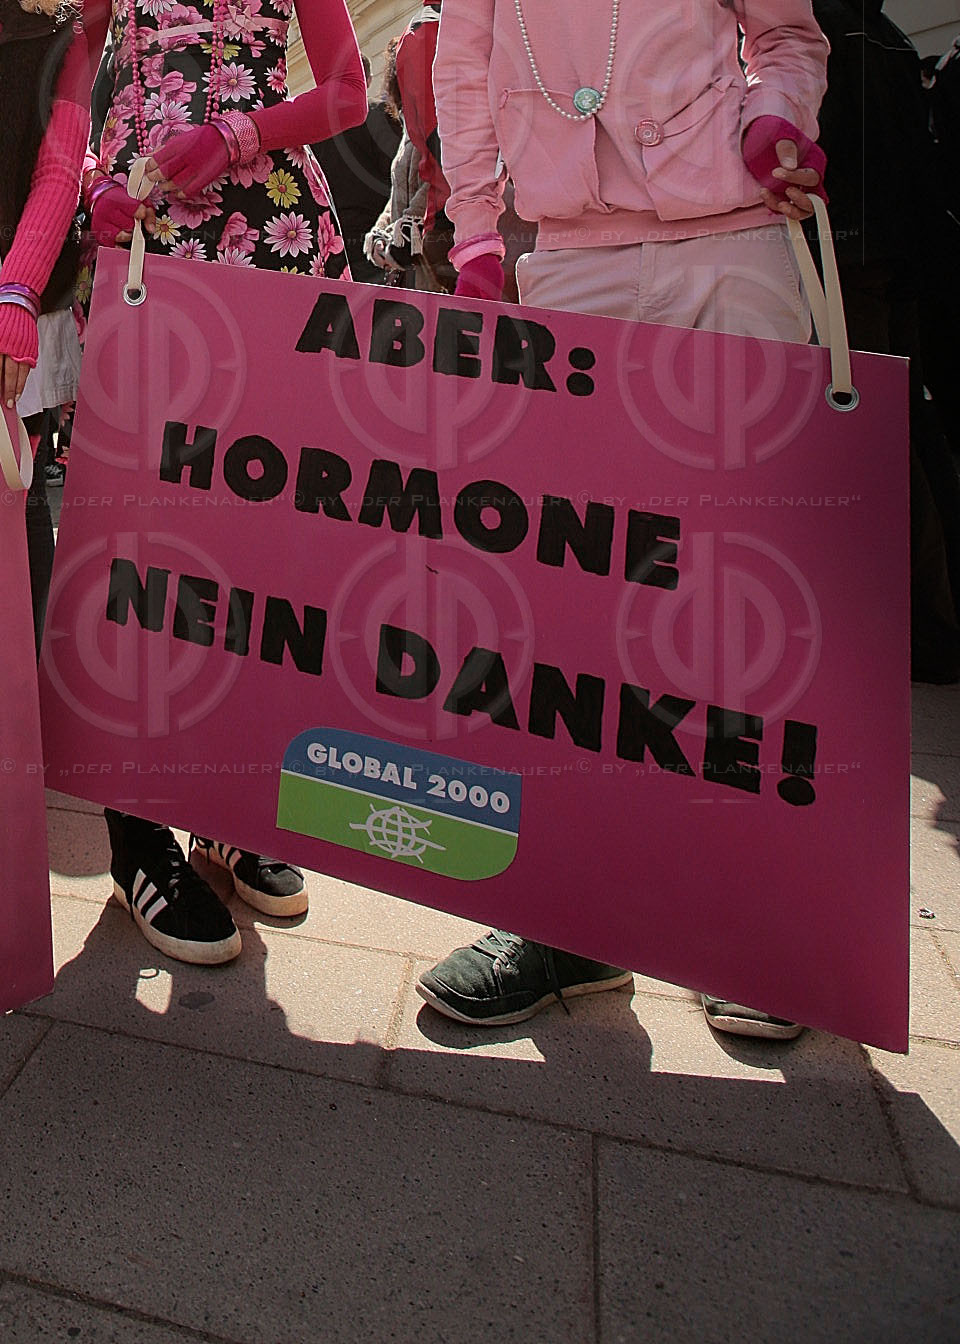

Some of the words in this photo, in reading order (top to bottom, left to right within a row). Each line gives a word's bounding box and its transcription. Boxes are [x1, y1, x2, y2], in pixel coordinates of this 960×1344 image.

[295, 293, 596, 397] ABER:
[159, 421, 681, 591] HORMONE
[106, 558, 328, 677] NEIN
[375, 624, 819, 807] DANKE!
[306, 742, 417, 790] GLOBAL
[426, 774, 510, 814] 2000
